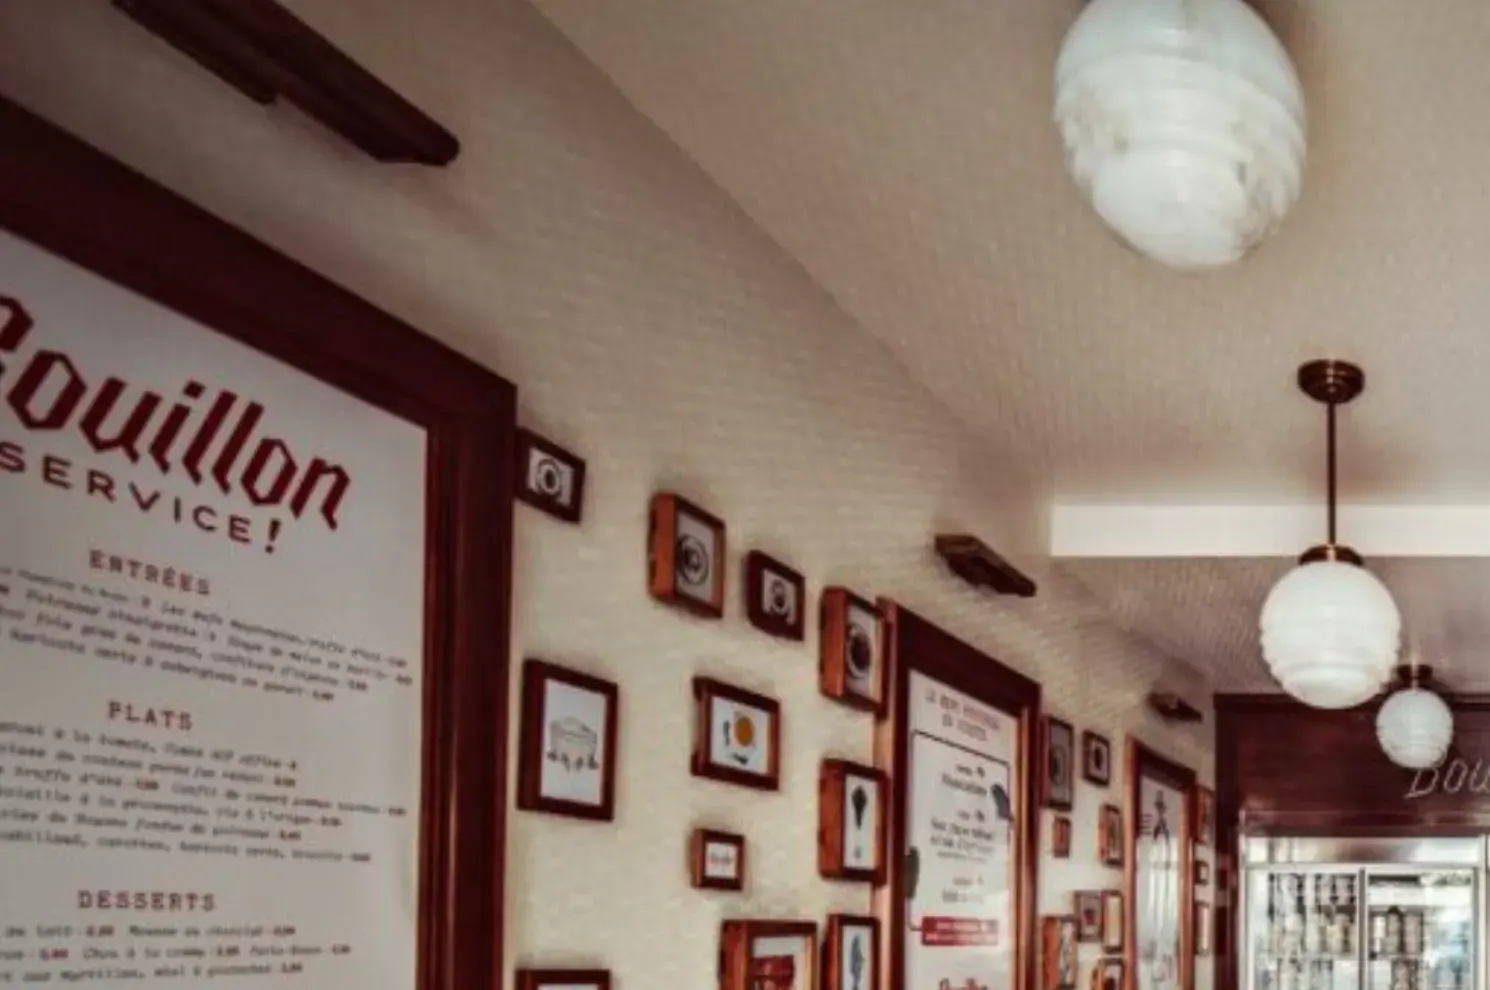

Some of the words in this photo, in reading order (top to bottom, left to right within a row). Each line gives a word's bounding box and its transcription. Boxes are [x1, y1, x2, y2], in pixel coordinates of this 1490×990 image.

[0, 440, 282, 554] SERVICE!
[108, 700, 193, 732] PLATS
[77, 889, 216, 913] DESSERTS
